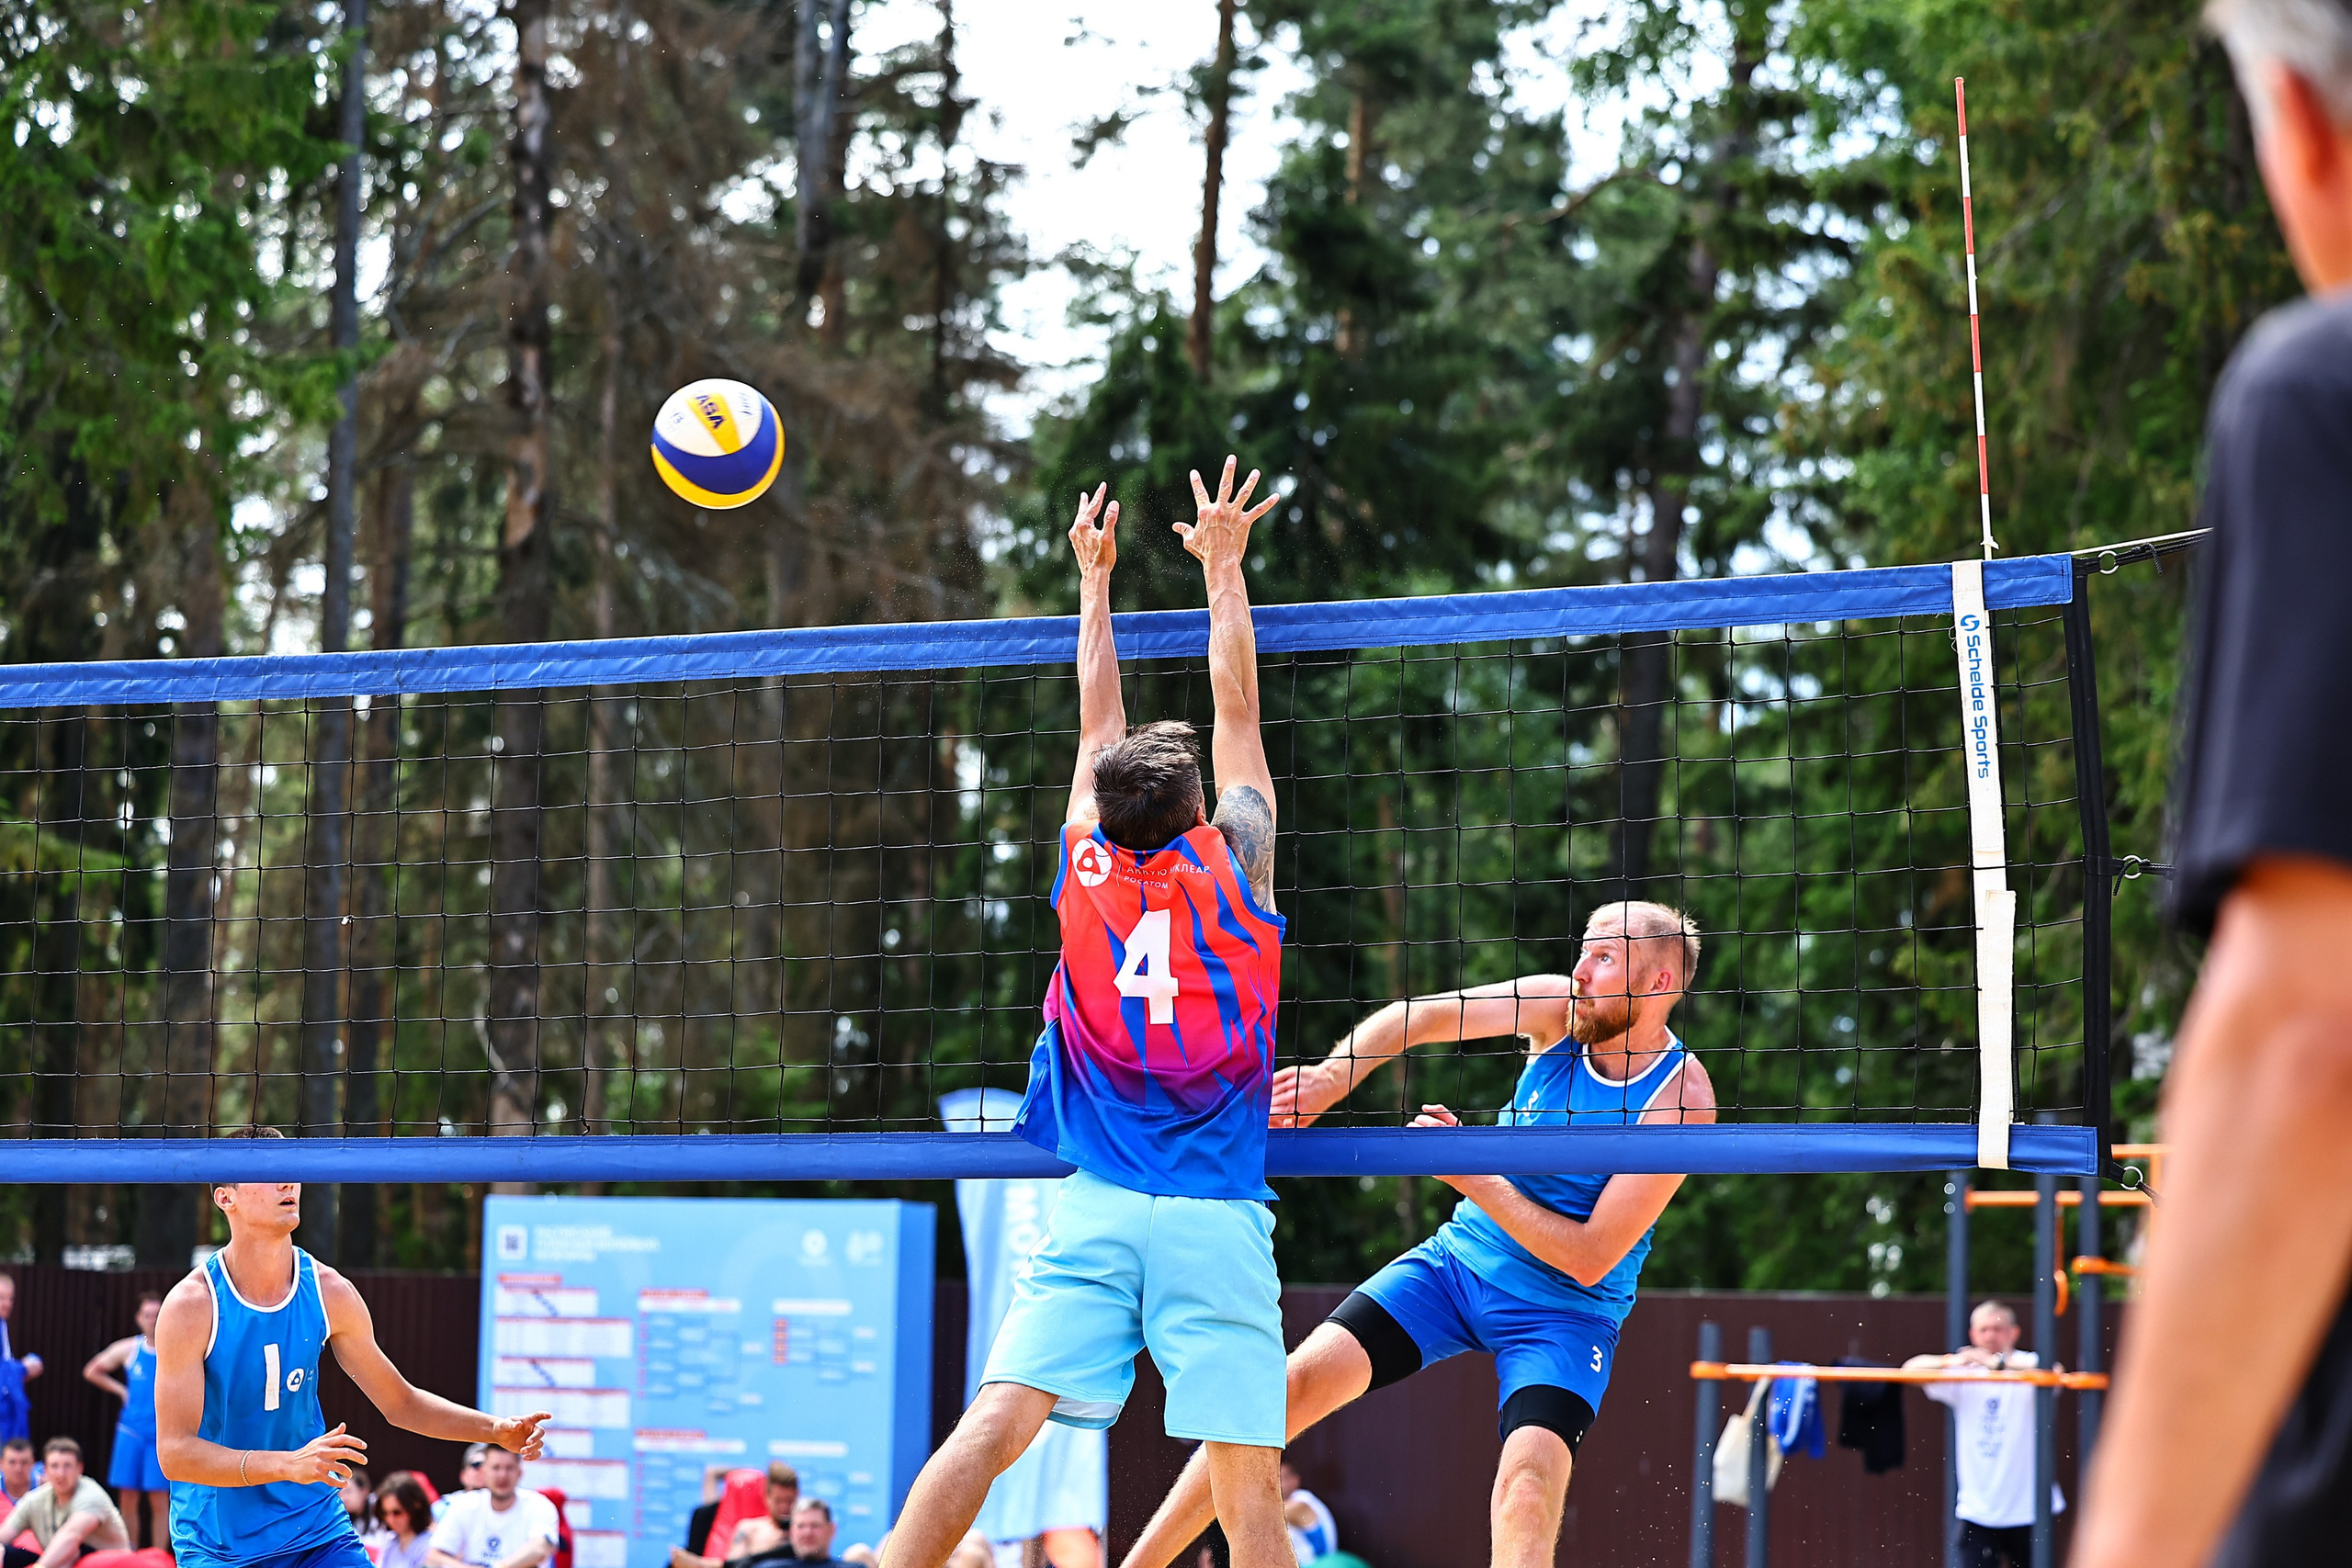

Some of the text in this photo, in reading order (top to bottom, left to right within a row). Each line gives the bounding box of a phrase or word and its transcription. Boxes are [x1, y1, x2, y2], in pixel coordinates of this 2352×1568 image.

[1966, 635, 1991, 779] Schelde Sports
[1124, 875, 1169, 889] РОСАТОМ
[1126, 866, 1168, 876] АККУЮ
[1113, 908, 1179, 1025] 4
